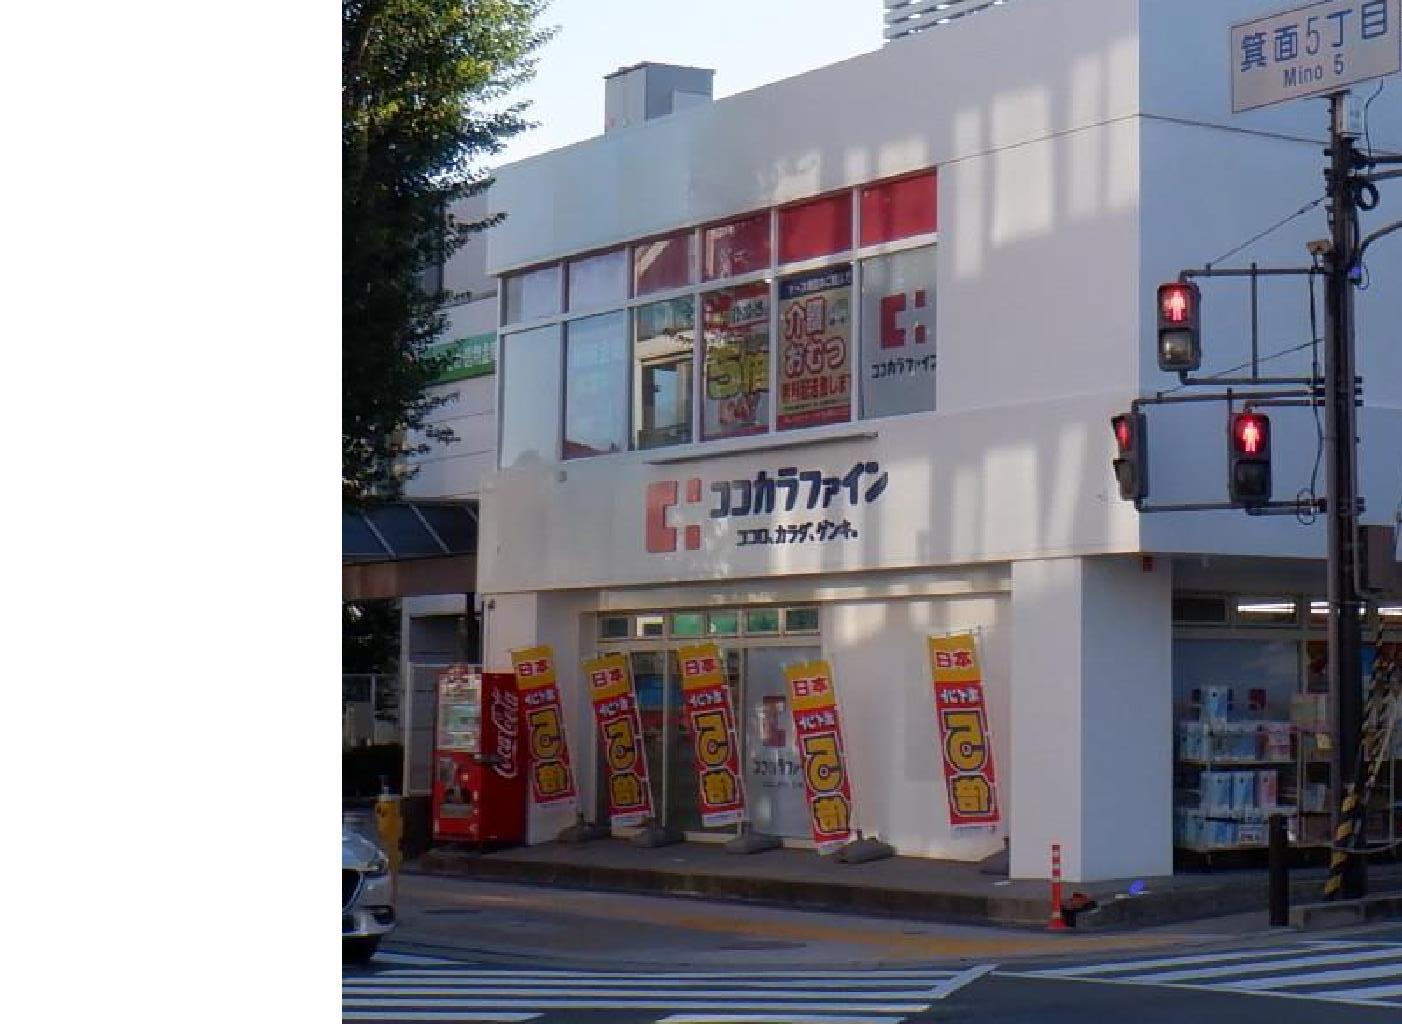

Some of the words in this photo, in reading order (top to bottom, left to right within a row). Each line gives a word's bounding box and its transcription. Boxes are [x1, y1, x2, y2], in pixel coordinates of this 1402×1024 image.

[1240, 0, 1387, 72] 箕面5丁目
[1283, 64, 1322, 88] Mino
[1333, 53, 1344, 75] 5
[711, 461, 888, 518] ココカラファイン
